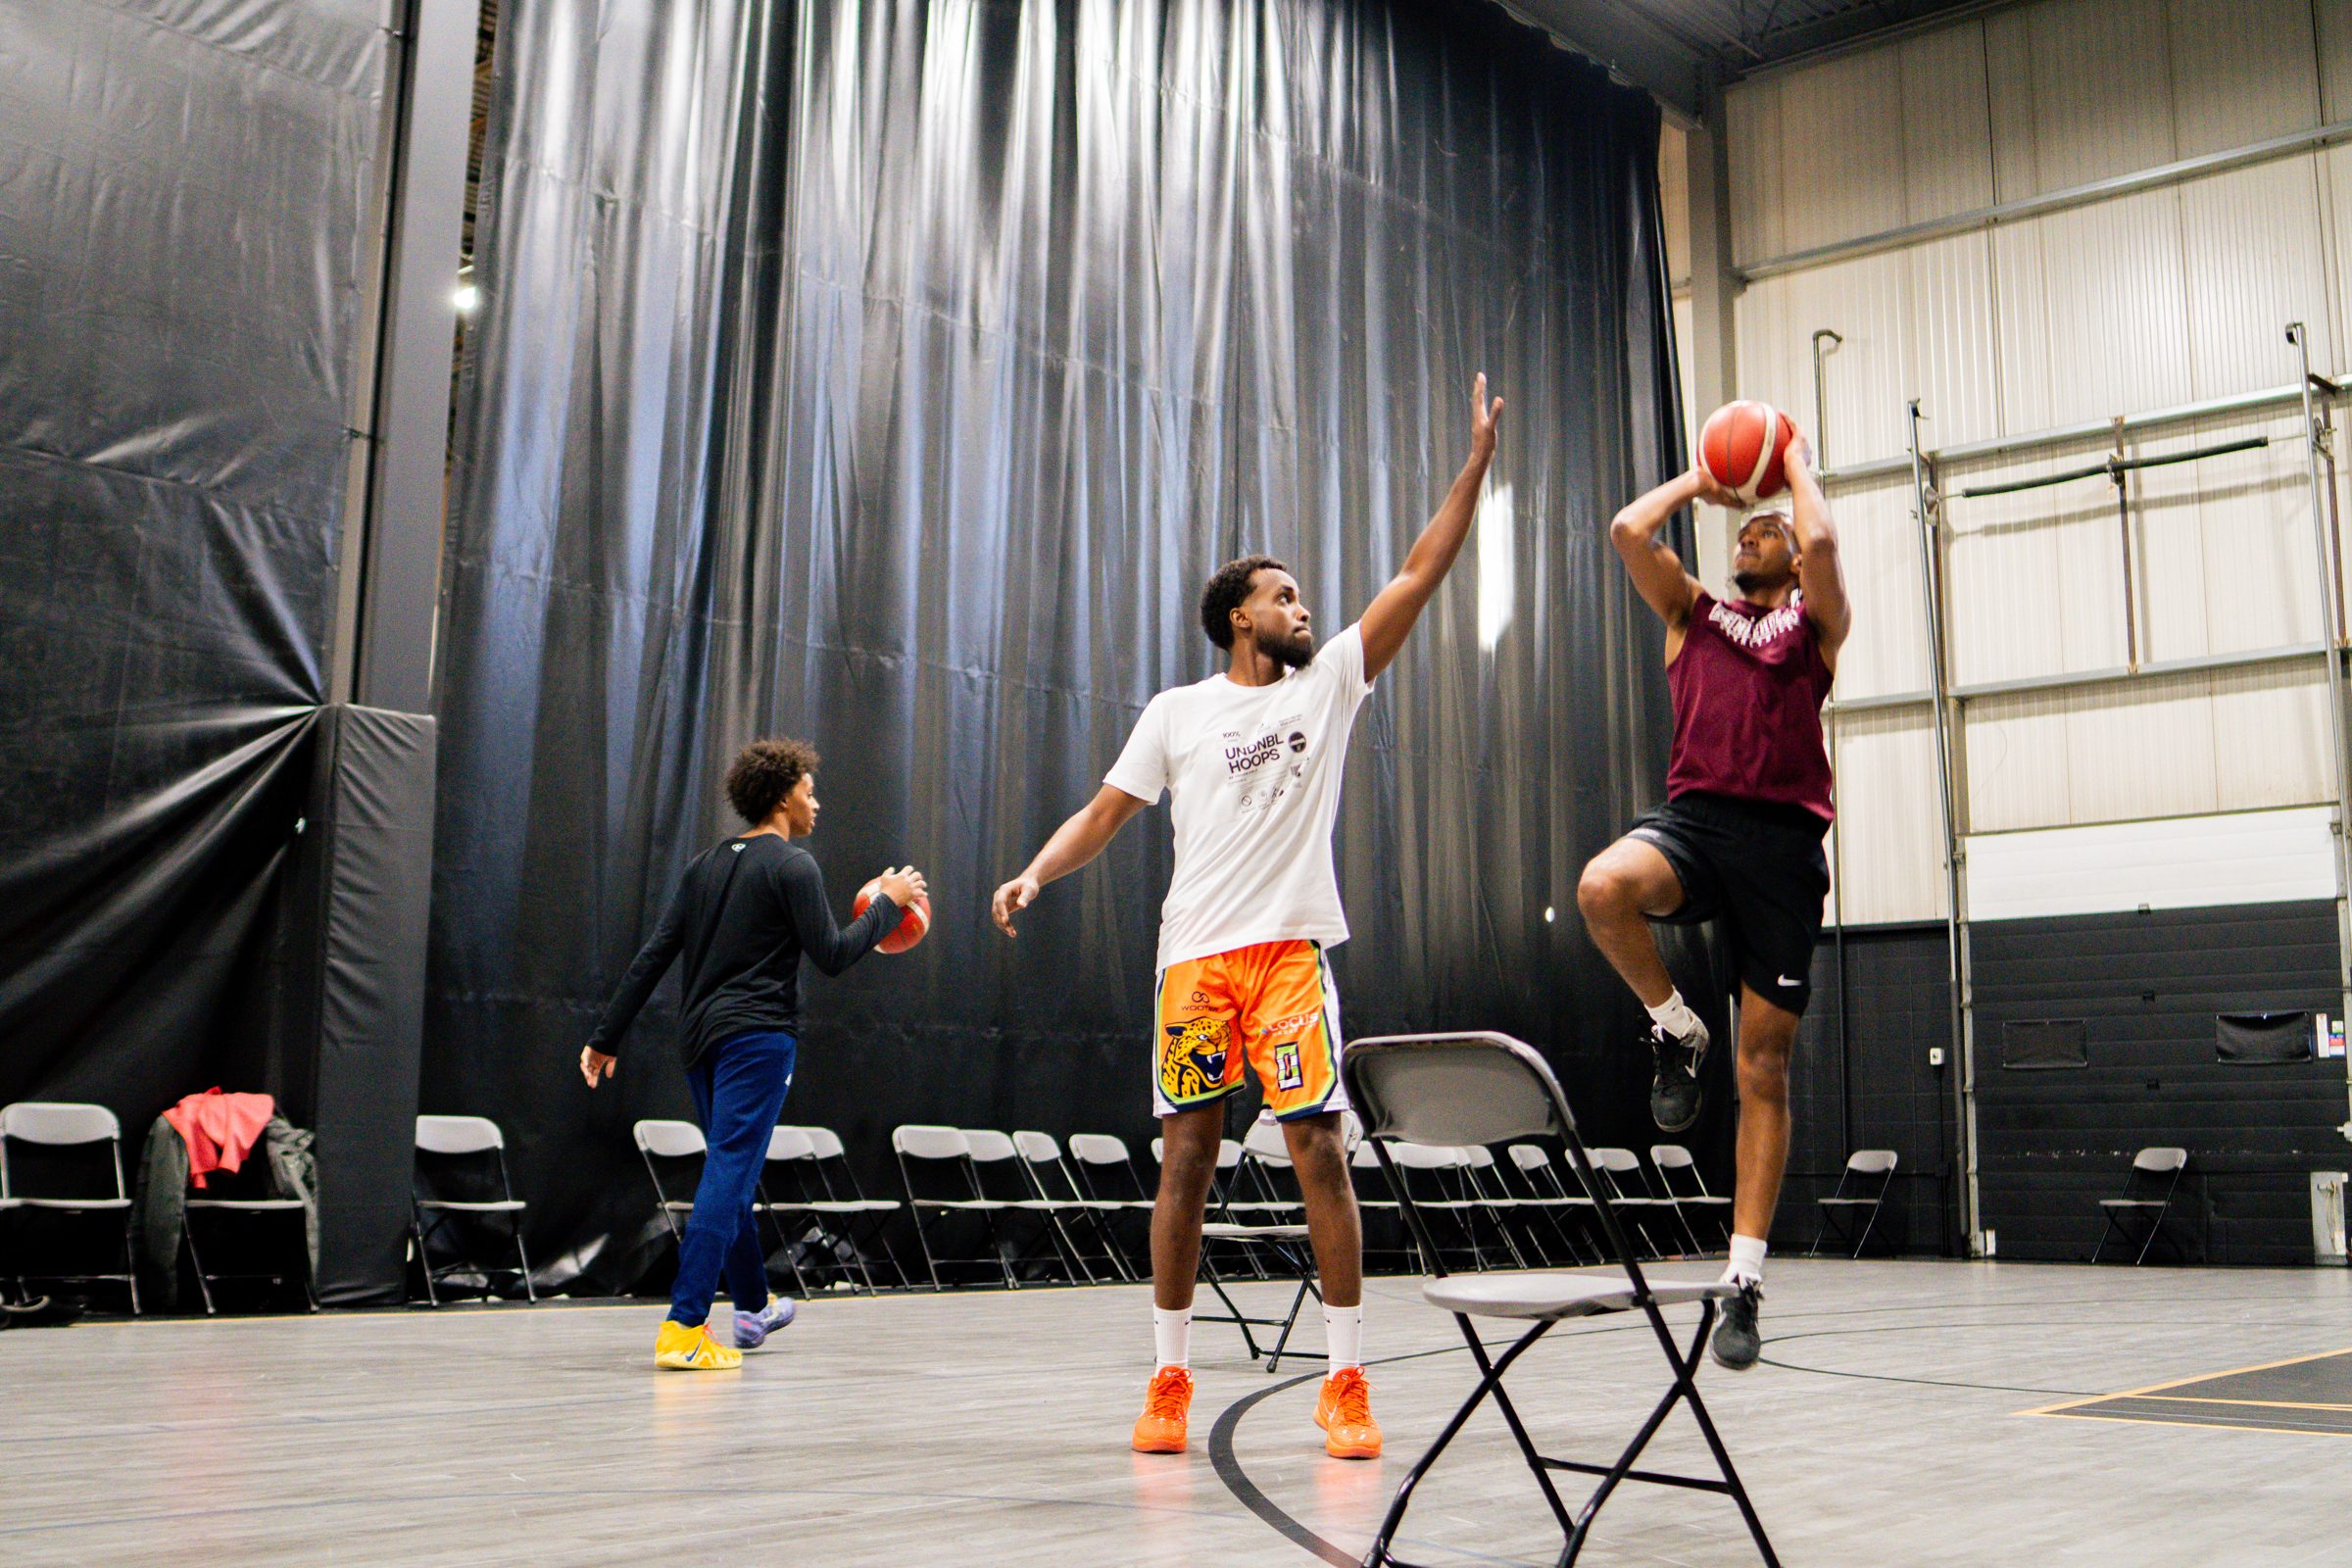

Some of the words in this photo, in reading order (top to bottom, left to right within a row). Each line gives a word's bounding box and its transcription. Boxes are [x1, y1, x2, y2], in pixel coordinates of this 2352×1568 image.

[1225, 733, 1284, 760] UNDNBL
[1228, 748, 1281, 774] HOOPS
[1268, 1012, 1319, 1032] LOCUS
[1275, 1041, 1303, 1092] 0
